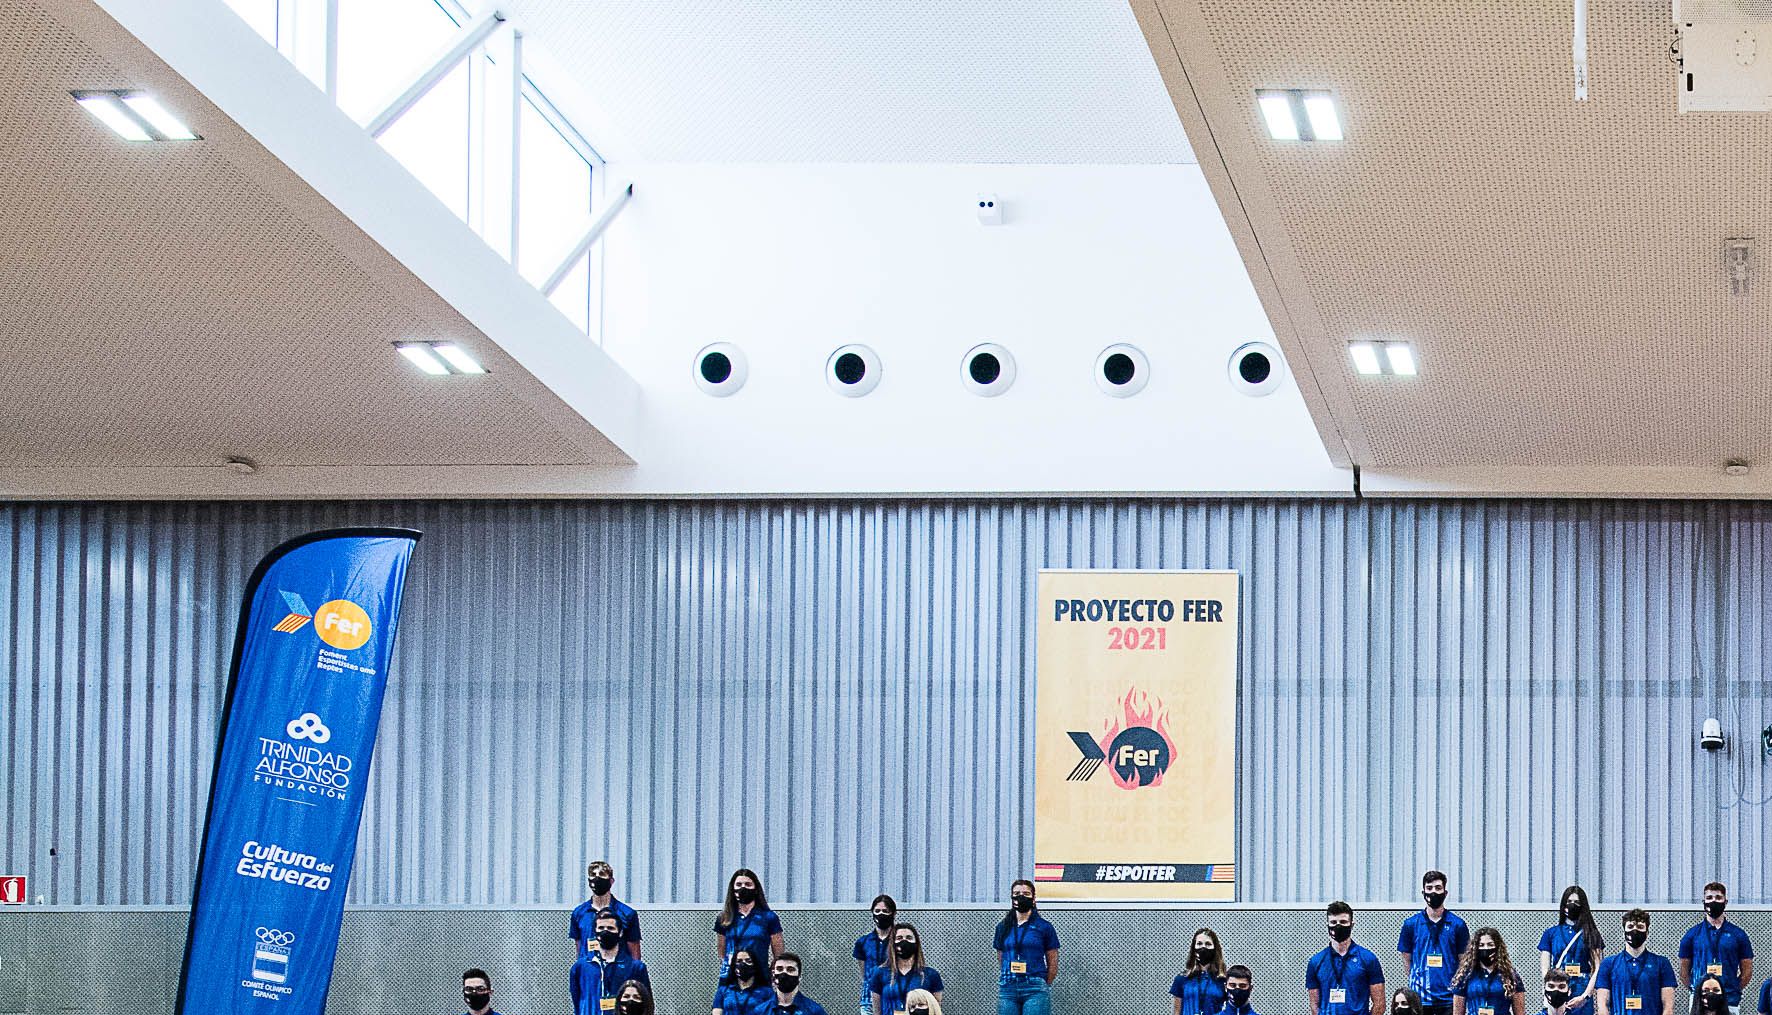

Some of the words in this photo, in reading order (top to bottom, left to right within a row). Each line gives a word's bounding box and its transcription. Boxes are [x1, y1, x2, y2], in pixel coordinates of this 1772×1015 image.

[1054, 599, 1175, 622] PROYECTO
[1183, 599, 1223, 622] FER
[324, 612, 363, 637] Fer
[1107, 627, 1167, 650] 2021
[360, 666, 376, 676] amb
[259, 737, 352, 771] TRINIDAD
[1119, 745, 1160, 767] Fer
[255, 758, 350, 789] ALFONSO
[254, 776, 346, 801] FUNDACIÓN
[242, 840, 316, 870] Cultura
[316, 861, 335, 874] del
[236, 858, 330, 891] Esfuerzo
[1095, 864, 1177, 881] #ESPOTFER
